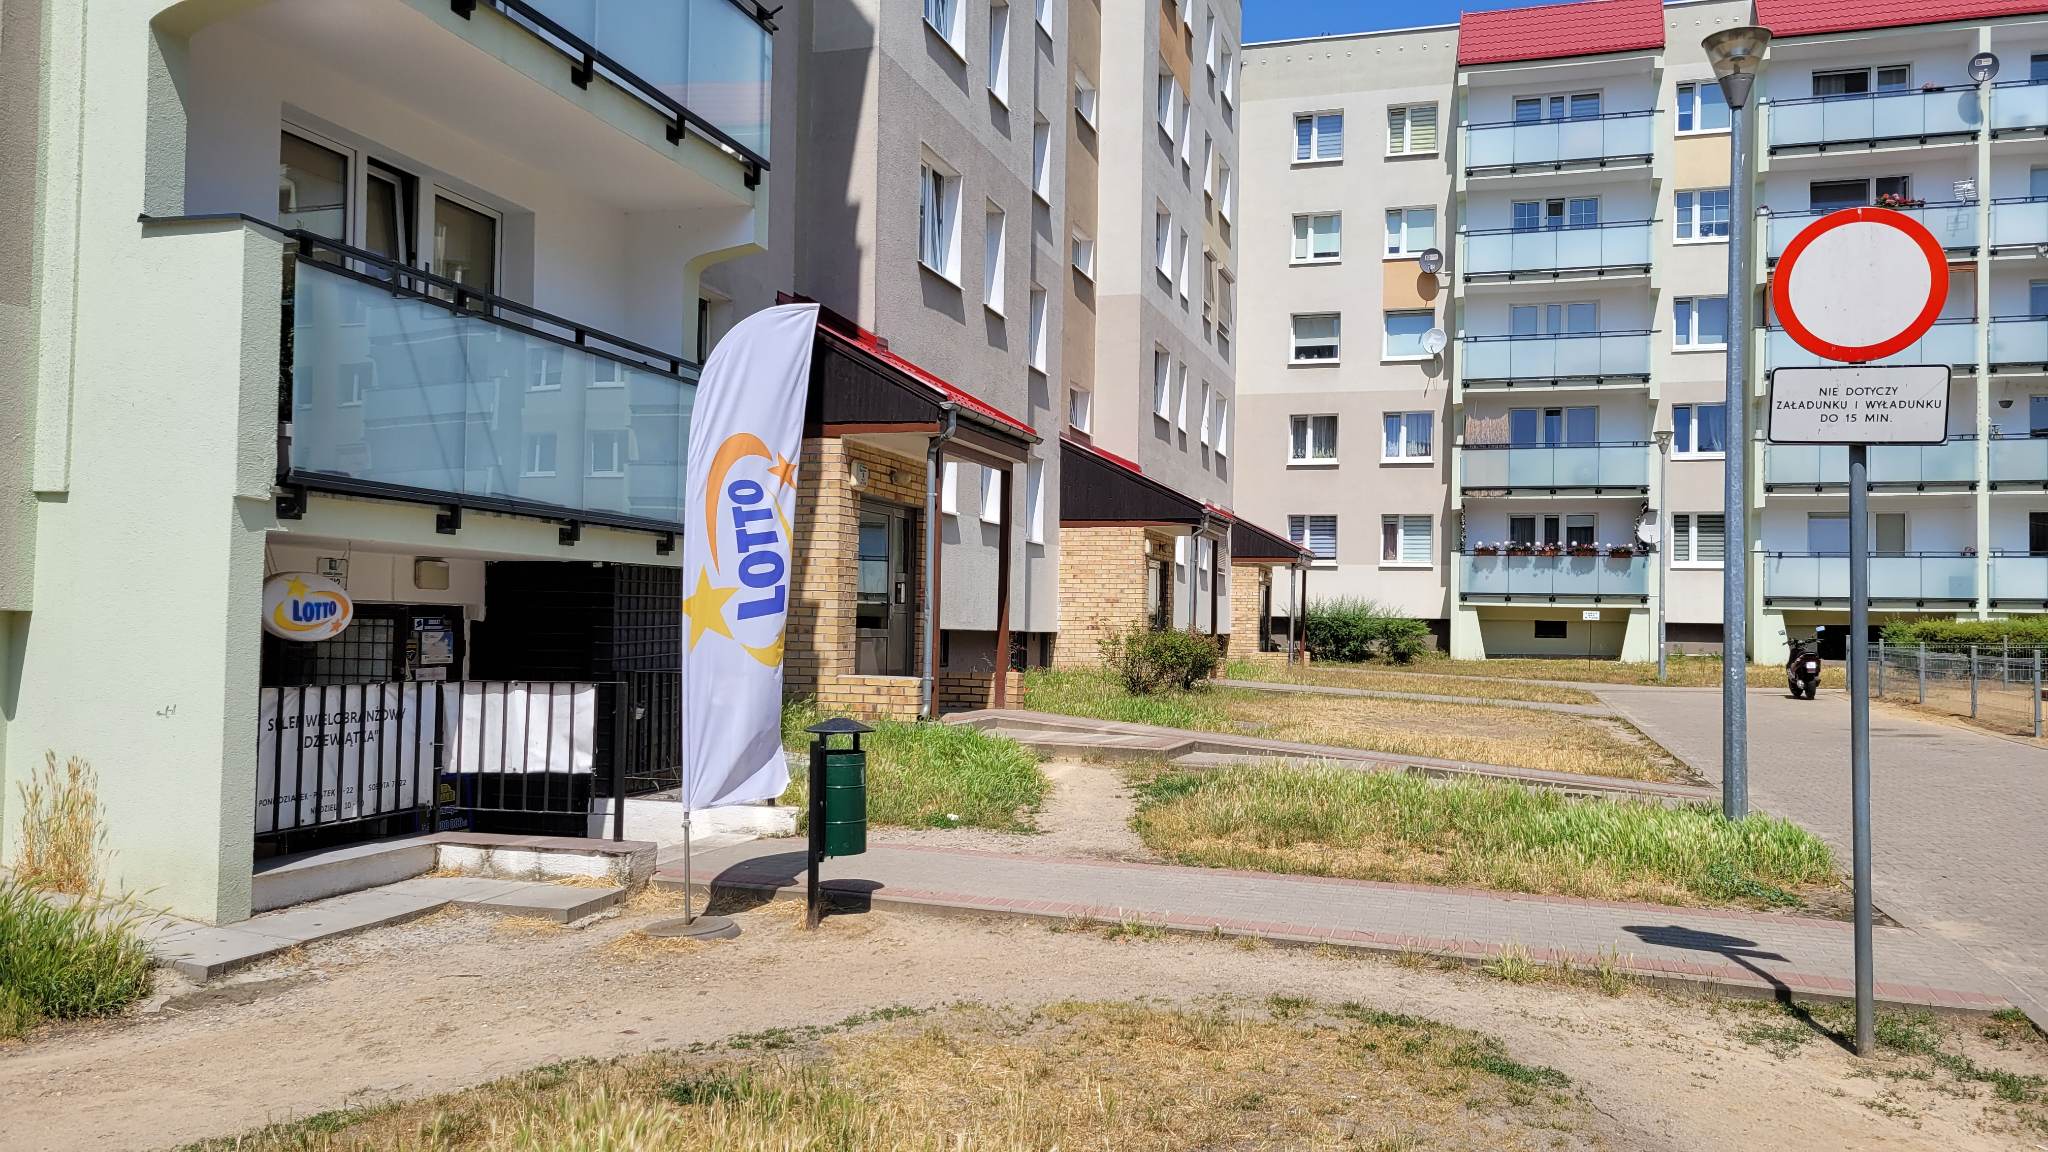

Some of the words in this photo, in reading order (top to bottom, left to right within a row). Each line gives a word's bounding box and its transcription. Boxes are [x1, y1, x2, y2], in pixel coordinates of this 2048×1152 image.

[1819, 387, 1839, 396] NIE
[1845, 387, 1899, 396] DOTYCZY
[1776, 401, 1848, 410] ZAŁADUNKU
[1866, 400, 1942, 409] WYŁADUNKU
[1820, 414, 1838, 422] DO
[1846, 414, 1857, 422] 15
[1864, 413, 1893, 422] MIN.
[727, 479, 785, 621] LOTTO
[292, 599, 337, 622] LOTTO
[268, 715, 302, 731] SLE
[368, 782, 389, 791] SOTA
